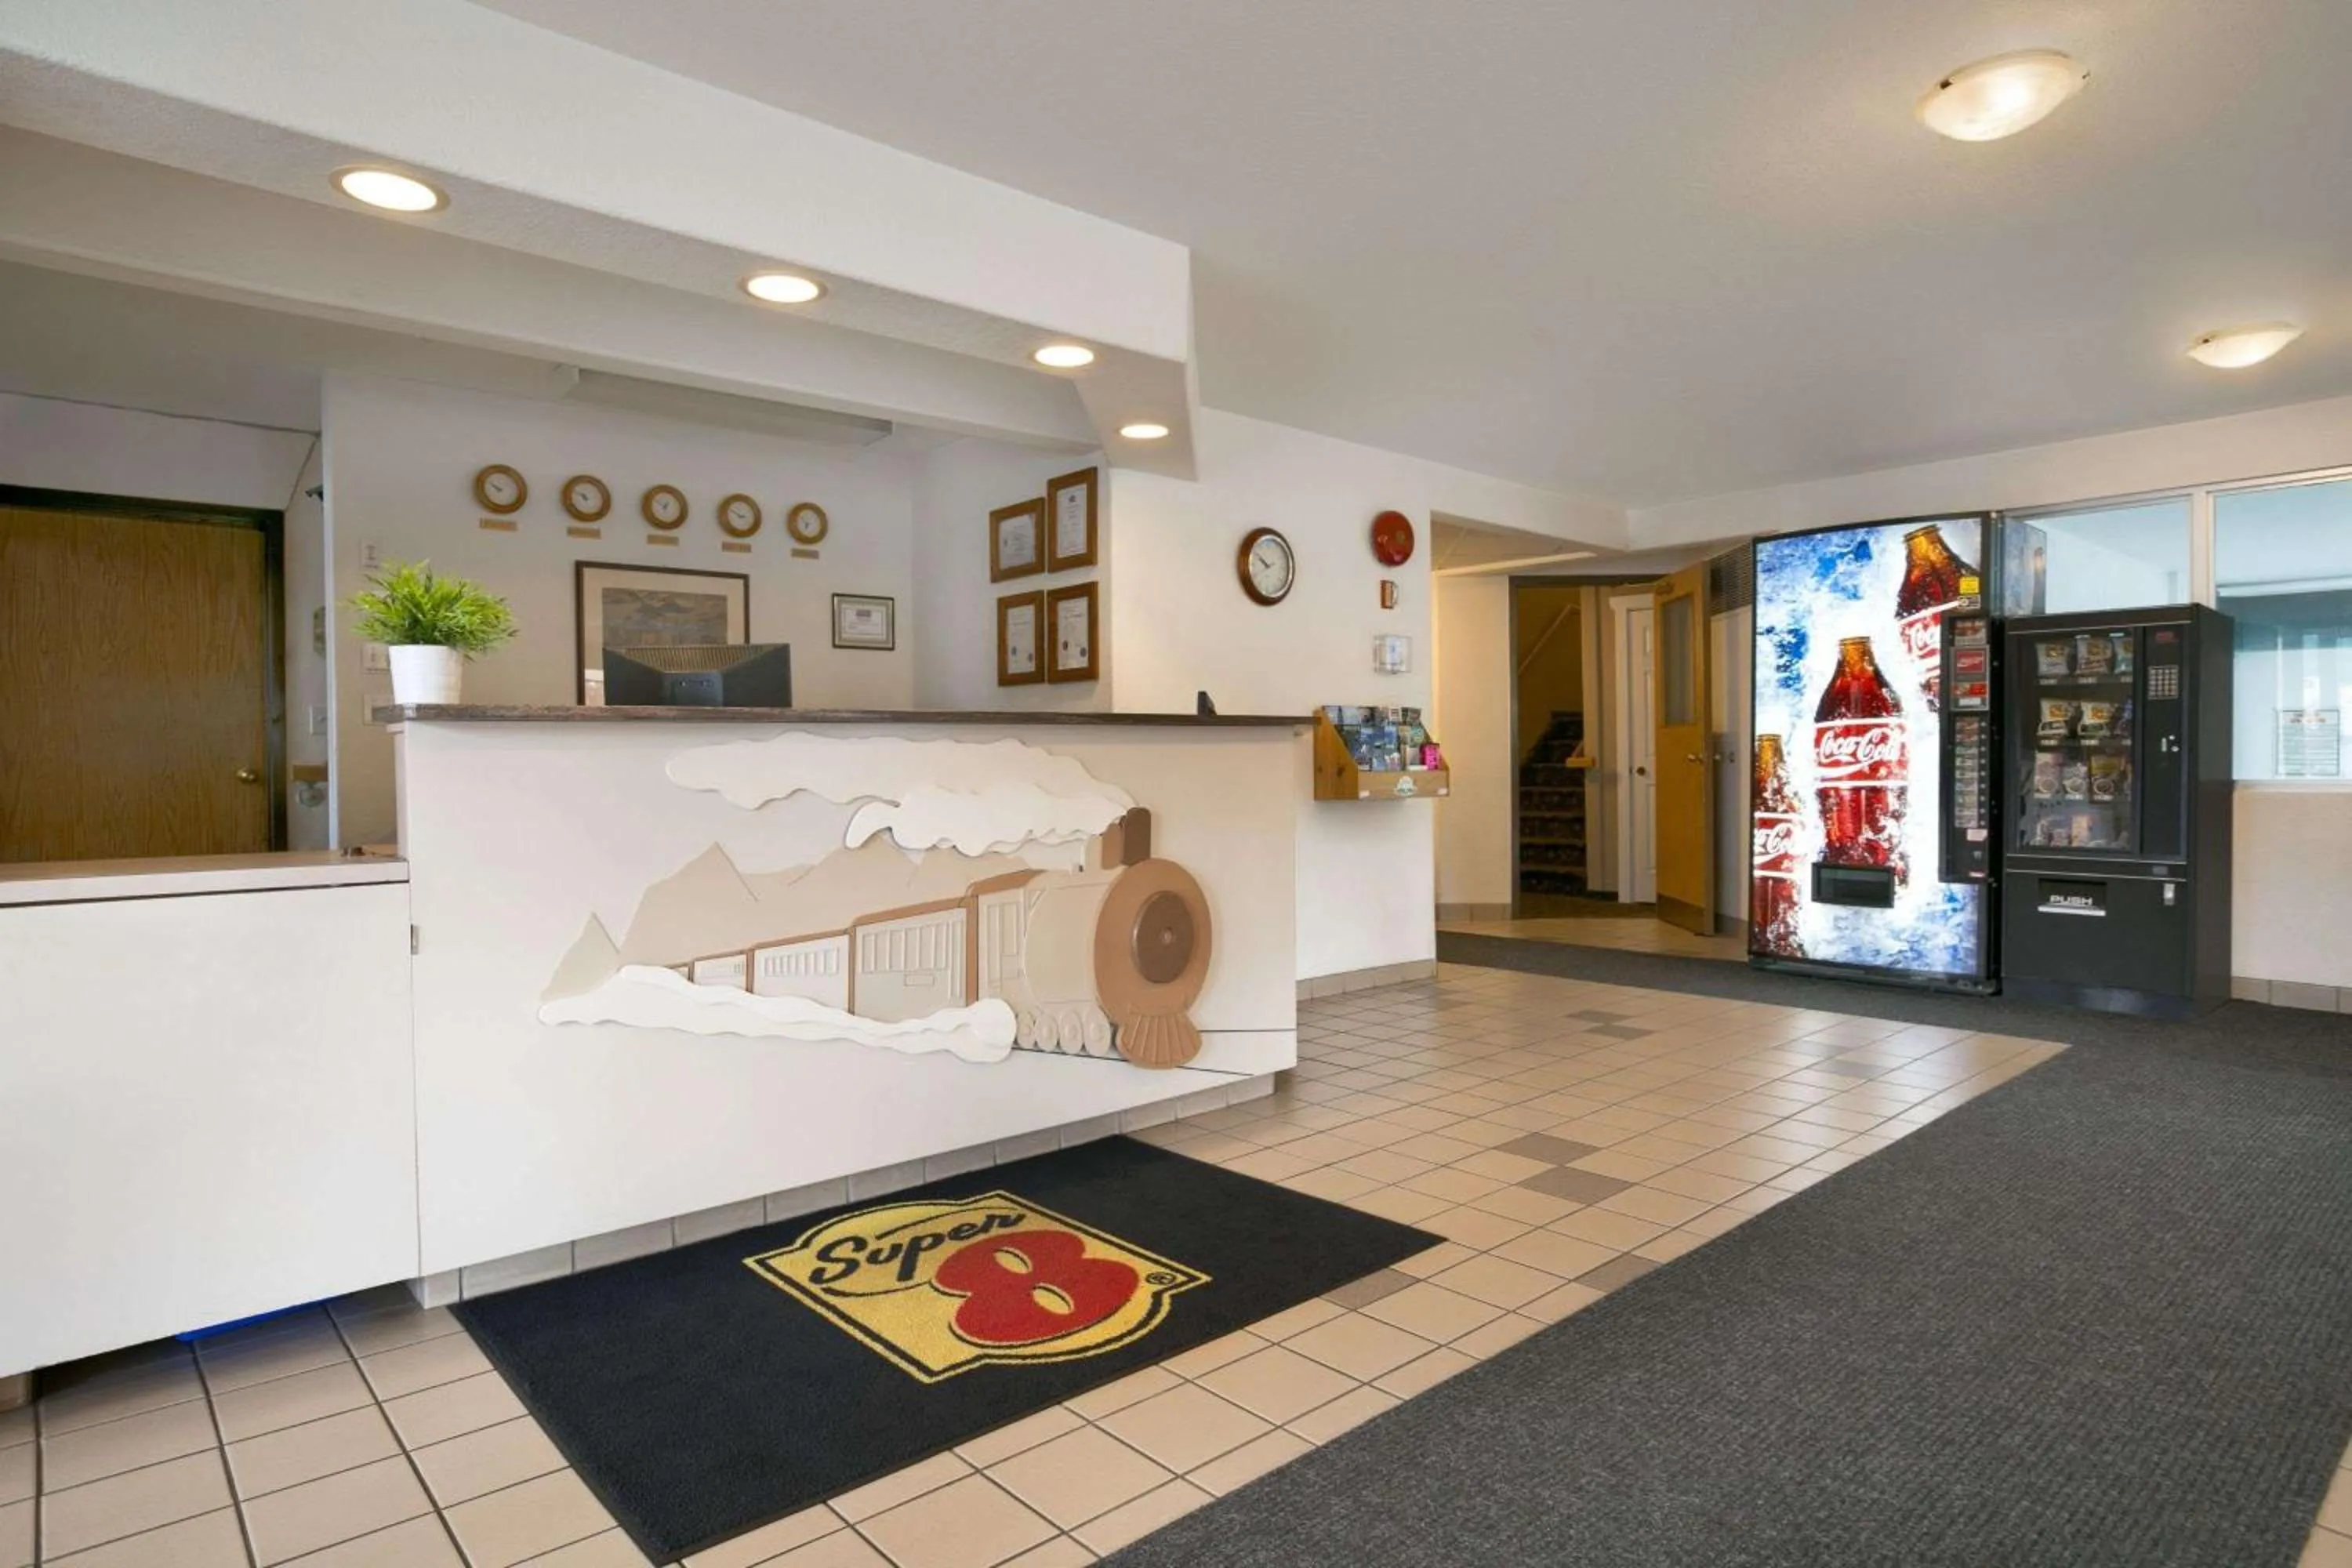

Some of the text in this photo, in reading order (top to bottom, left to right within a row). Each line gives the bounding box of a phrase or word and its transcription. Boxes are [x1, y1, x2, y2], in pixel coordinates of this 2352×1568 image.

[2049, 894, 2094, 906] PUSH
[808, 1213, 1026, 1285] Super
[932, 1229, 1141, 1347] 8
